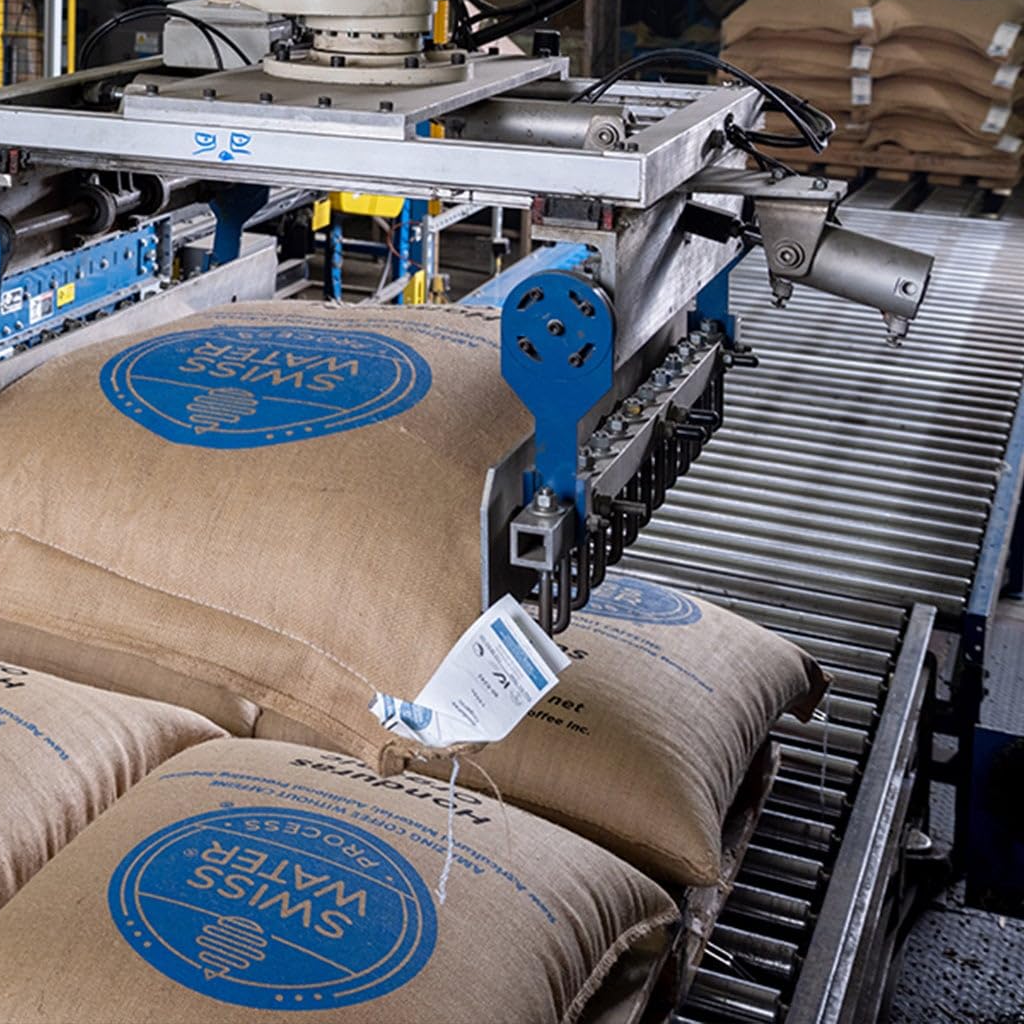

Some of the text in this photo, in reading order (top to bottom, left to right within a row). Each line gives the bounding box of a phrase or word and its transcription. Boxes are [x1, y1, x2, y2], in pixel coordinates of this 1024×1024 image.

[178, 356, 345, 391] SWISS
[193, 341, 359, 376] WATER
[527, 709, 564, 726] offee
[277, 790, 347, 815] WITHOUT
[289, 757, 491, 825] Honduras
[351, 810, 407, 838] COFFEE
[244, 819, 381, 869] PROCESS
[201, 840, 367, 917] WATER
[186, 865, 354, 939] SWISS
